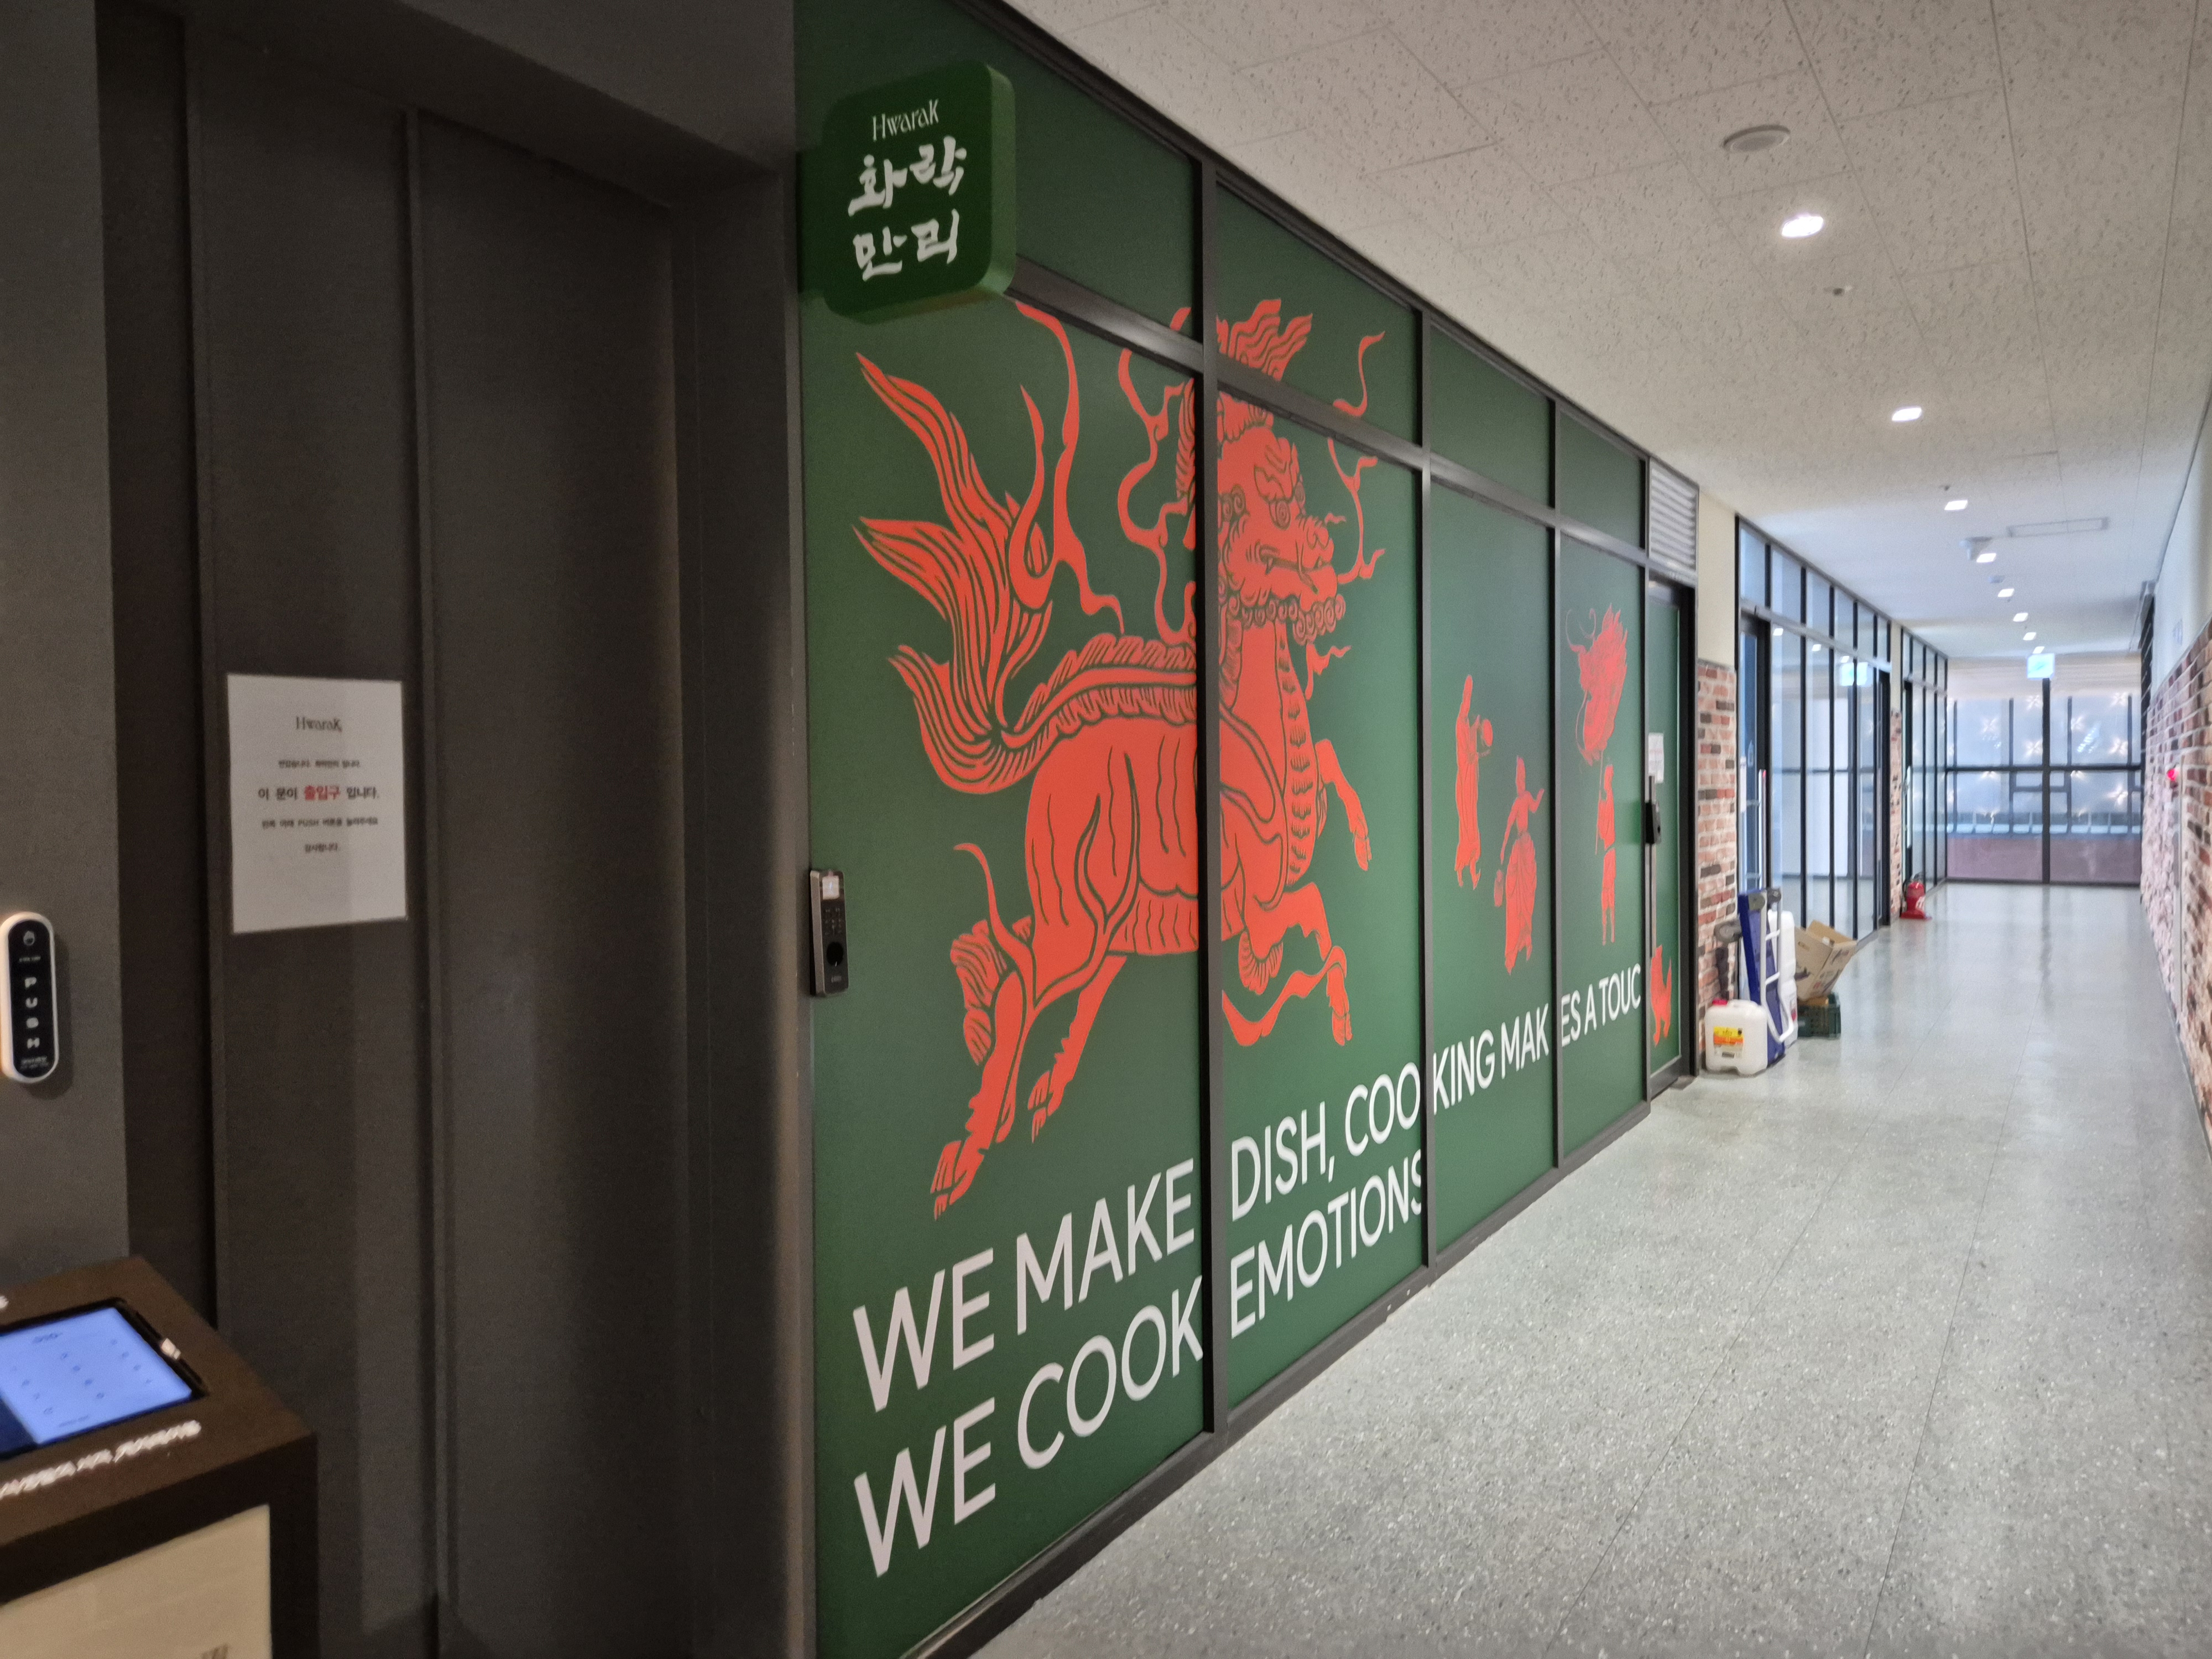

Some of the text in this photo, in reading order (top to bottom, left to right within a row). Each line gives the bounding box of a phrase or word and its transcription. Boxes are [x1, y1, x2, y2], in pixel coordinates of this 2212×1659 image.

[873, 99, 939, 142] Hwarak
[848, 135, 967, 217] 화락
[853, 208, 959, 281] 만리
[258, 787, 269, 800] 이
[276, 787, 297, 801] 문이
[305, 785, 340, 800] 출입구
[853, 1248, 994, 1412] WE
[1016, 1158, 1194, 1335] MAKE
[1232, 1101, 1334, 1222] DISH,
[1584, 984, 1597, 1035] A
[1599, 963, 1641, 1026] TOUC
[853, 1149, 1422, 1577] WE COOK EMOTIONS
